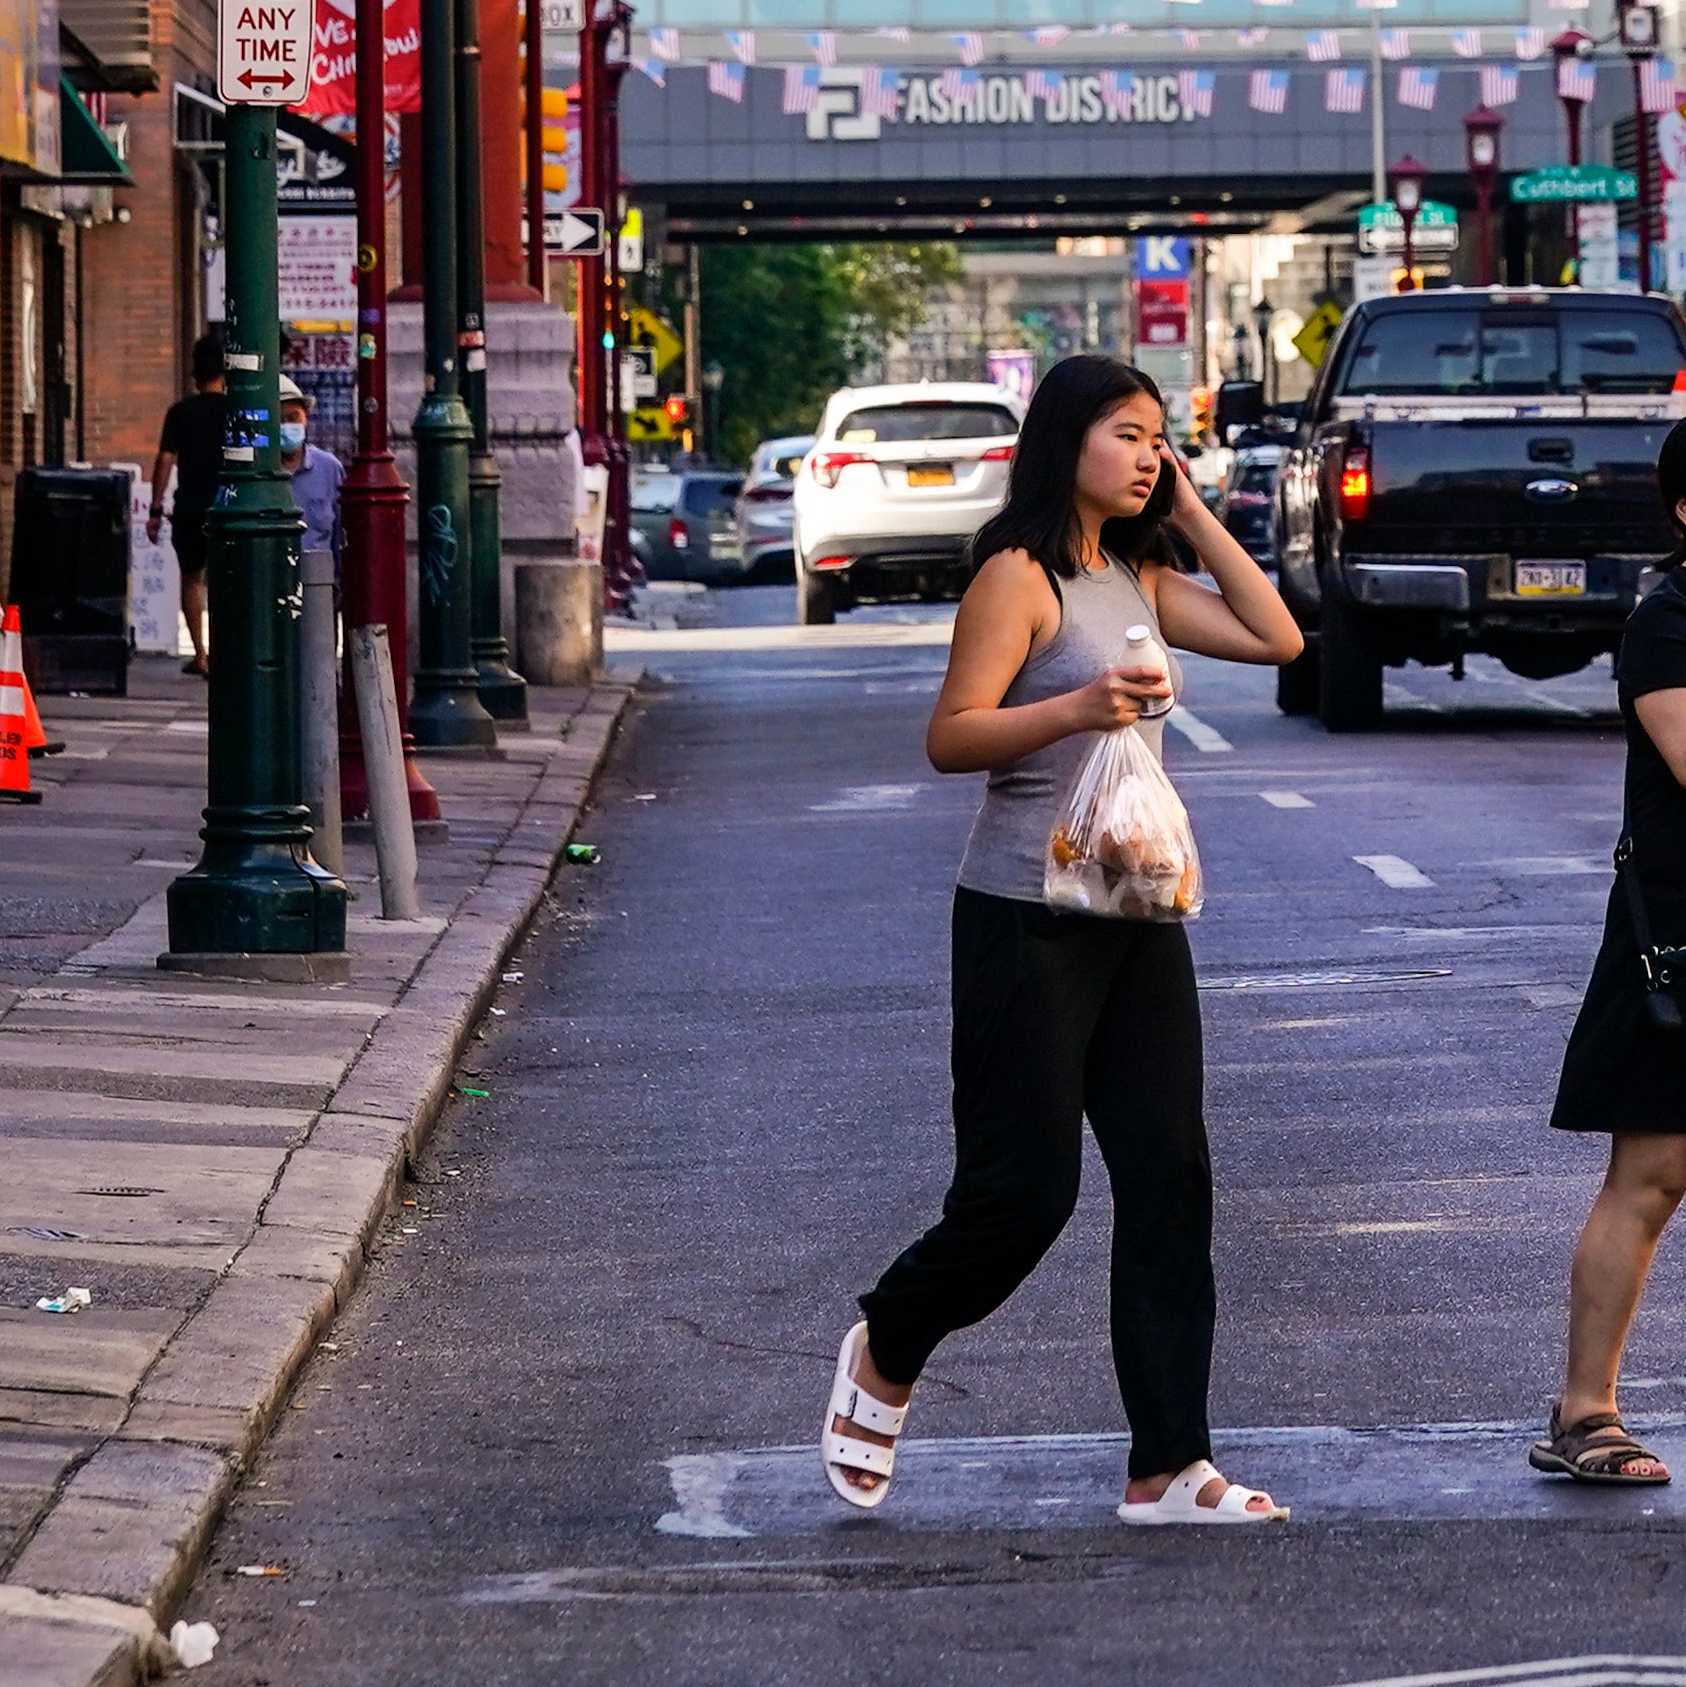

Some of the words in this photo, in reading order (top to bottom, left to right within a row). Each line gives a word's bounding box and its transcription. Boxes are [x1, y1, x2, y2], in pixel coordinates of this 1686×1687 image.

[237, 7, 296, 30] ANY
[236, 38, 296, 63] TIME
[1513, 175, 1608, 200] Cuthbert
